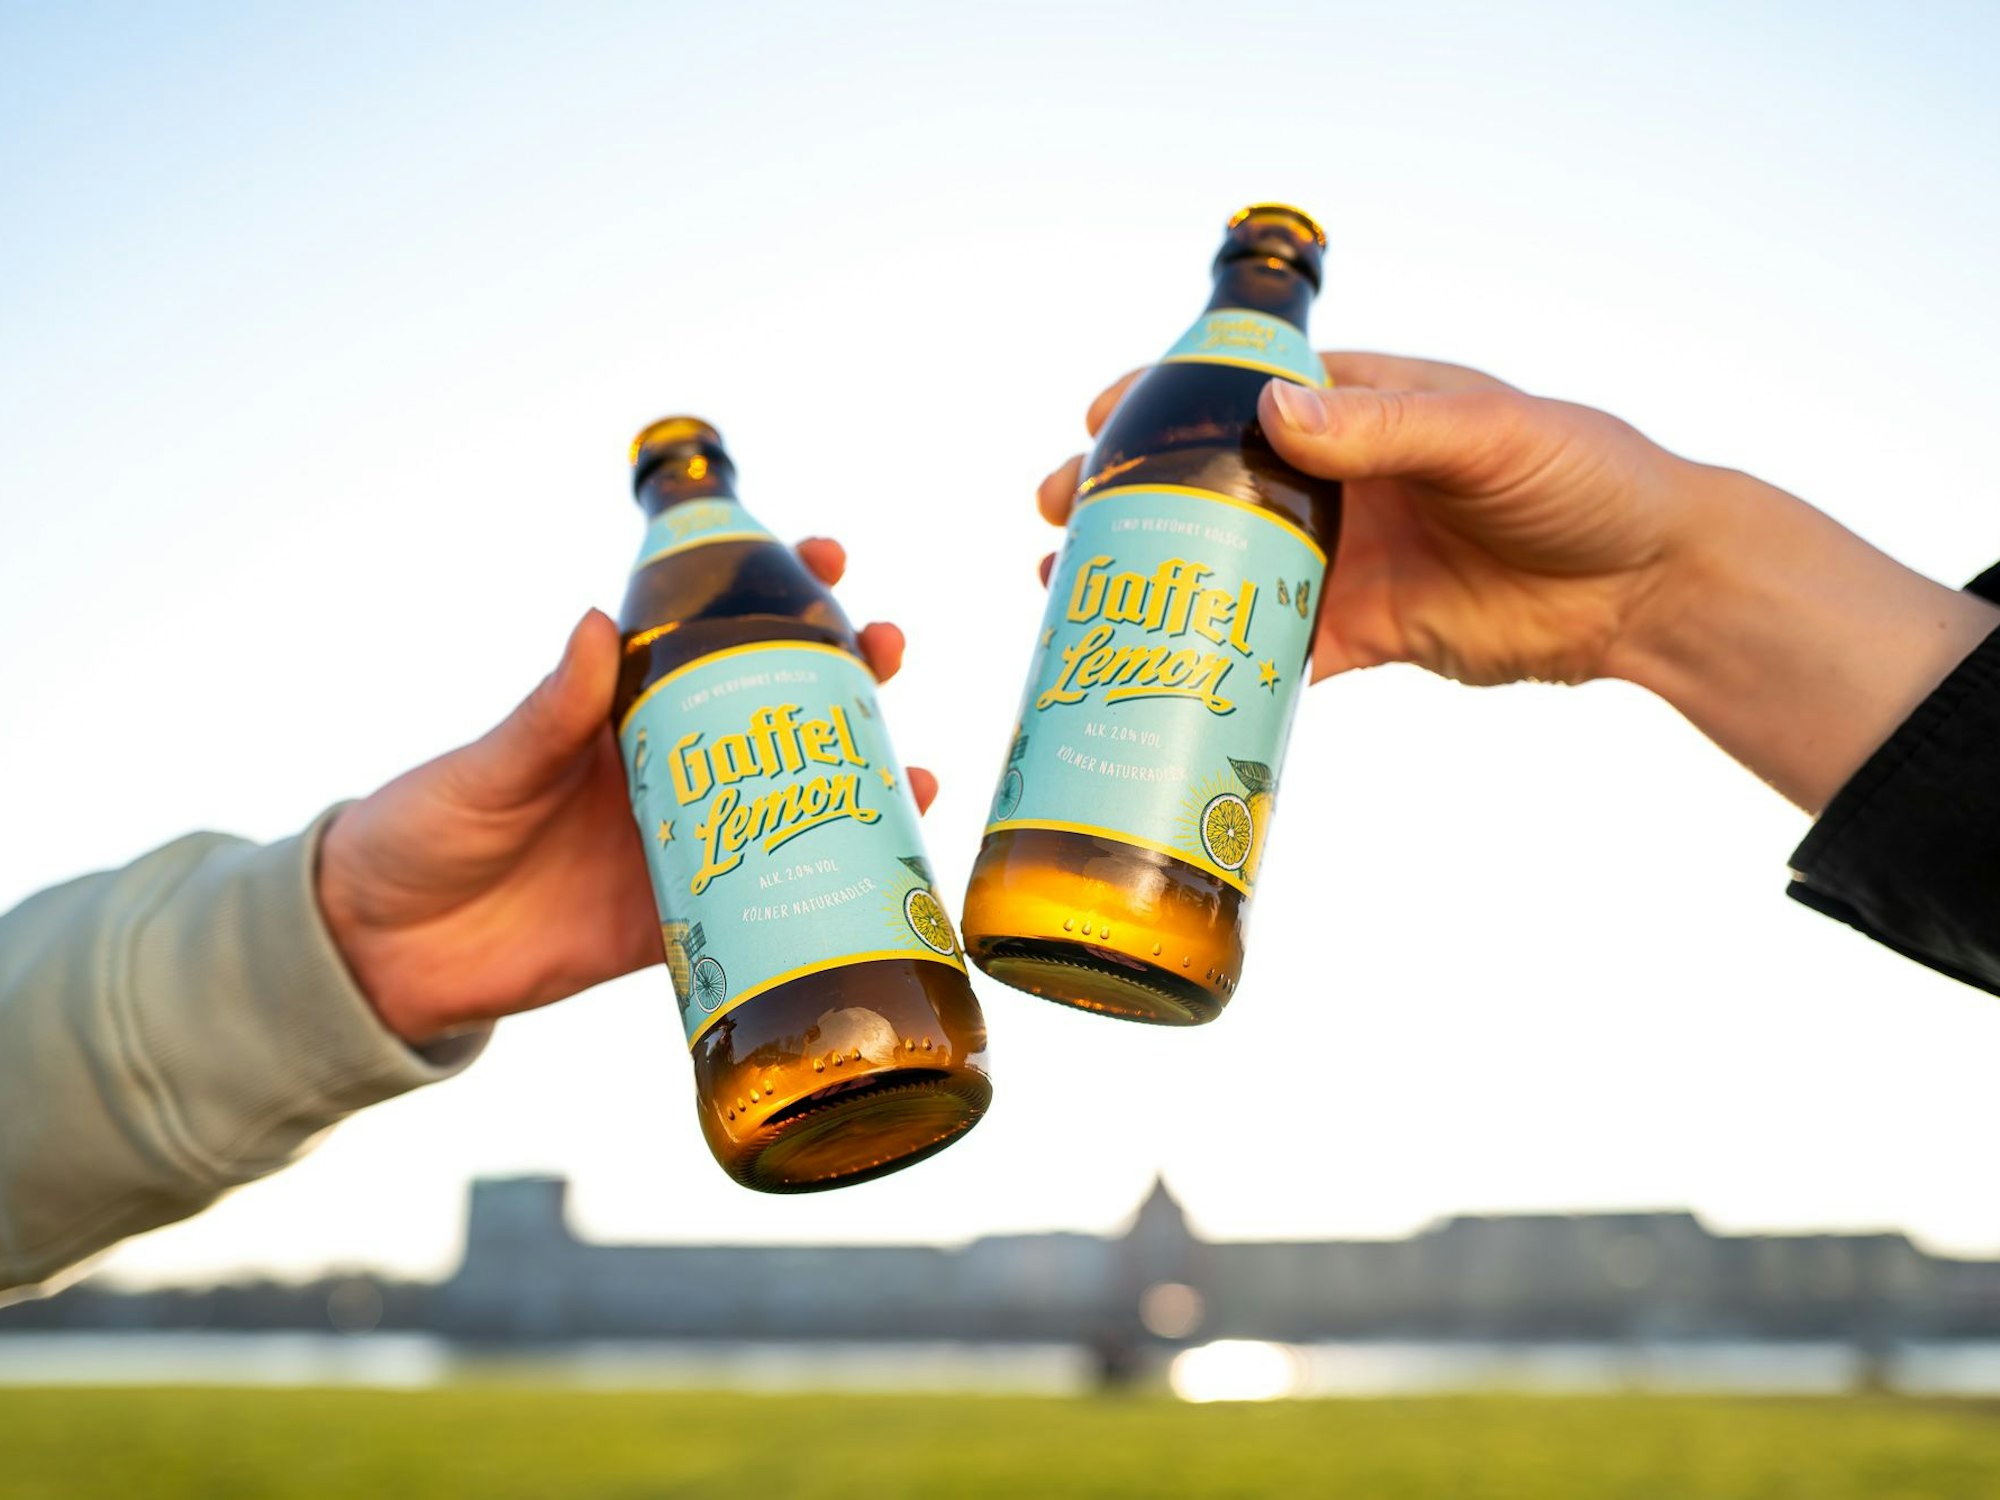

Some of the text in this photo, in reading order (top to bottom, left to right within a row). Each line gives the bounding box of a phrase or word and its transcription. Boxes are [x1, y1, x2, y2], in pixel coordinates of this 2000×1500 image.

[1066, 555, 1259, 658] Gaffel
[1035, 624, 1237, 716] Lemon
[667, 703, 870, 806] Gaffel
[1056, 744, 1097, 773] KÖLNER
[1140, 730, 1162, 748] VOL
[690, 773, 882, 896] Lemon
[815, 859, 839, 873] VOL
[742, 877, 877, 922] KÖLNER NATURRADLER
